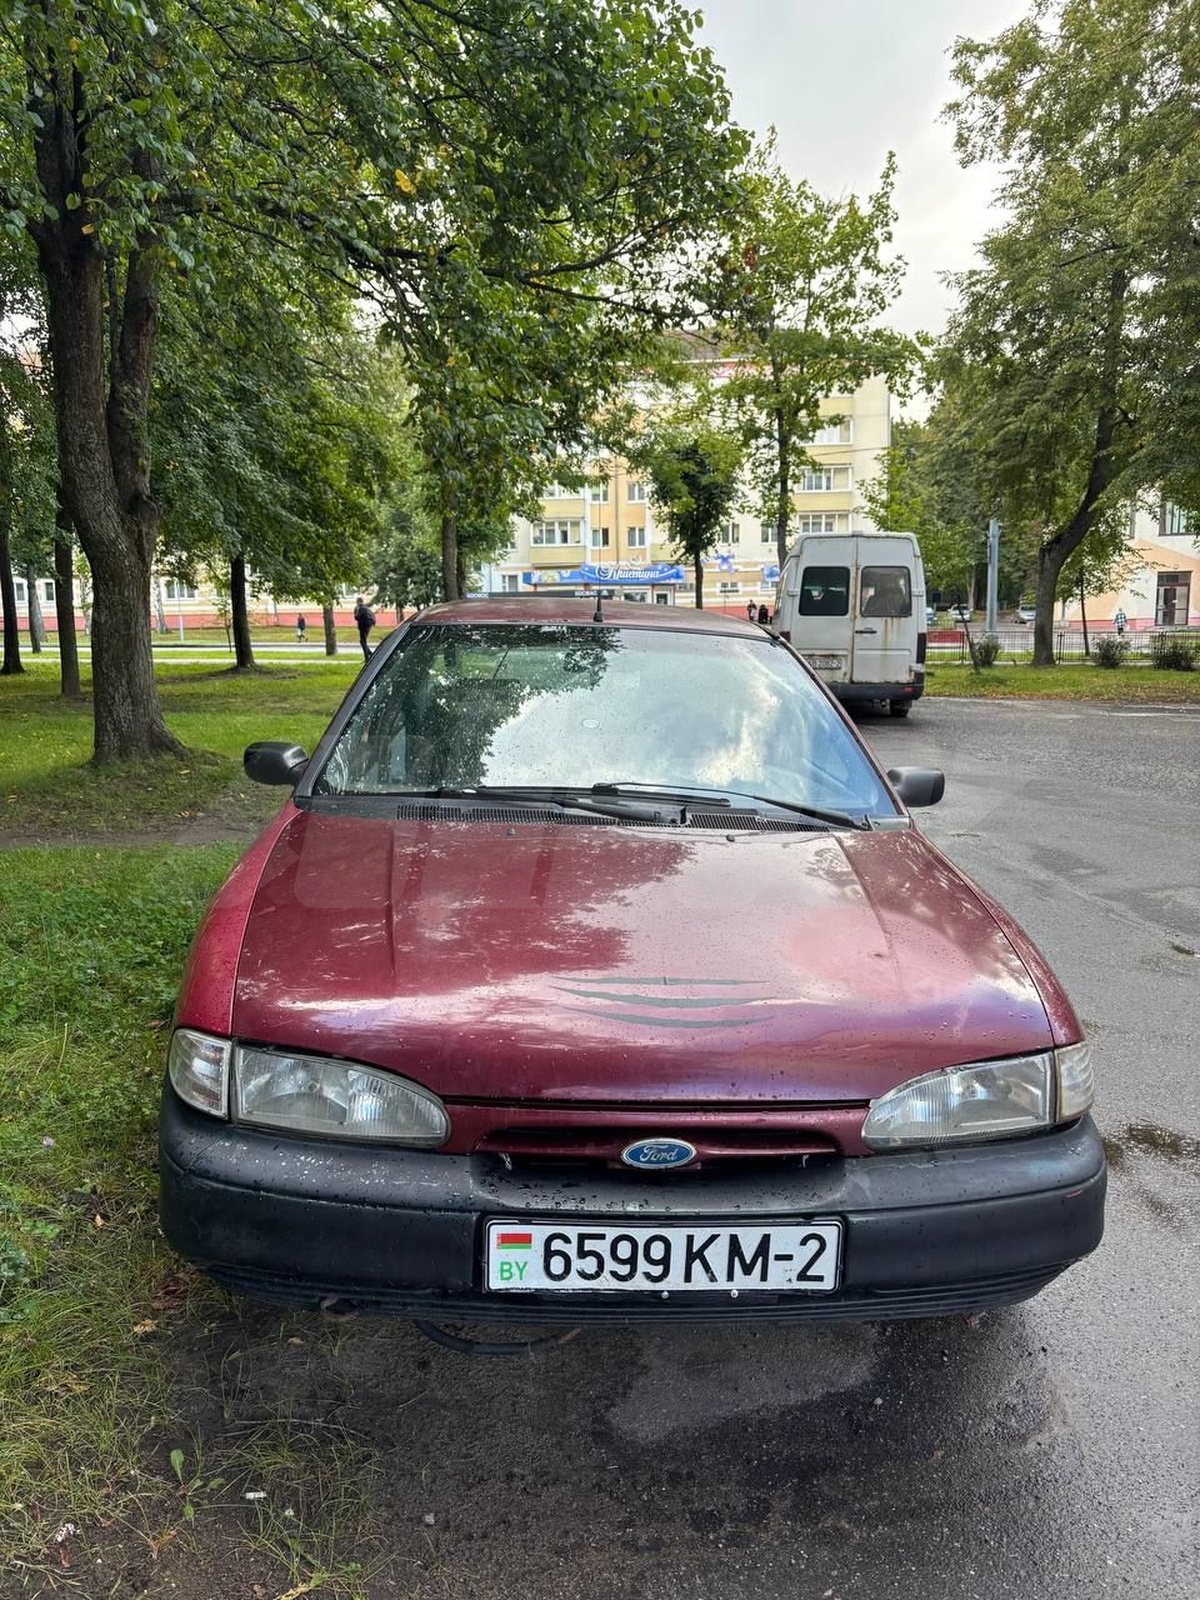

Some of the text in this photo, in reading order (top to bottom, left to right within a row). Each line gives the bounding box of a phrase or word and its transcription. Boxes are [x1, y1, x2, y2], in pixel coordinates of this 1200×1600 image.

[640, 1145, 679, 1162] Ford
[543, 1232, 828, 1284] 6599 KM-2
[499, 1260, 528, 1281] BY
